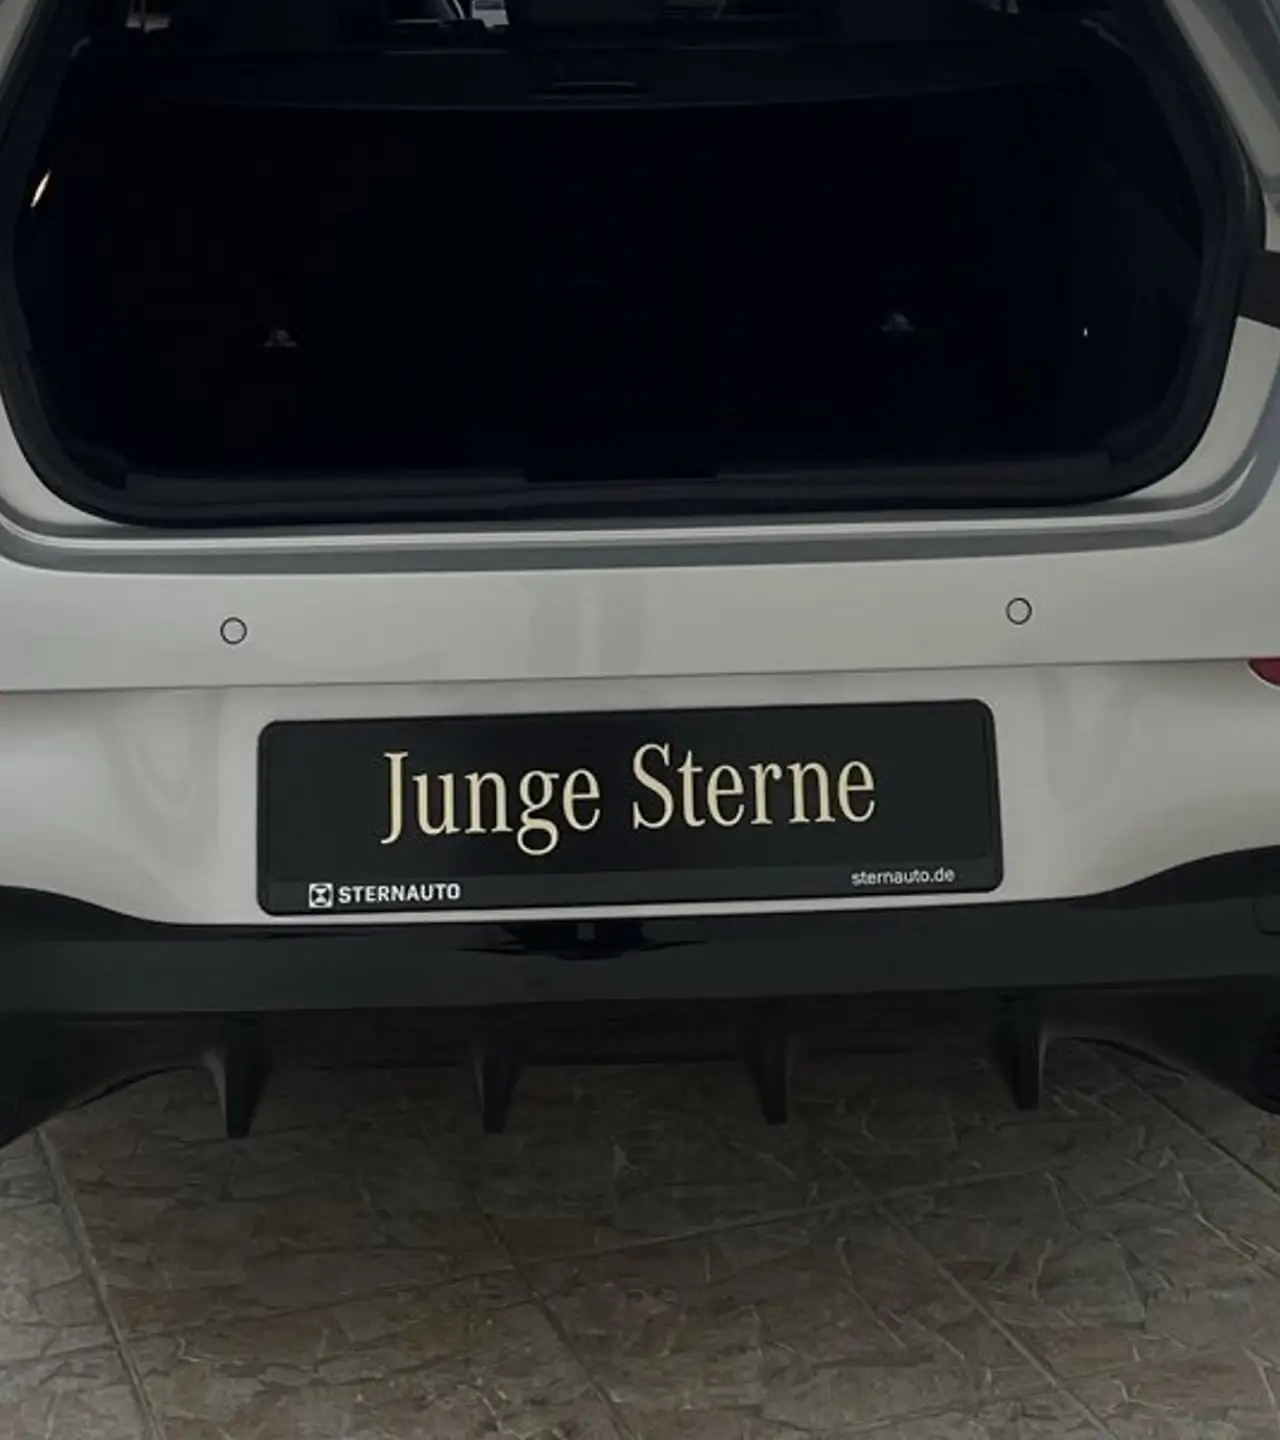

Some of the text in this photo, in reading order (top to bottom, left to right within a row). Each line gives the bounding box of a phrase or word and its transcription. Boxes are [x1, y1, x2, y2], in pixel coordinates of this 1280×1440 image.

[381, 743, 875, 856] Junge Sterne
[851, 866, 956, 887] sternauto.de
[337, 883, 461, 904] STERNAUTO
